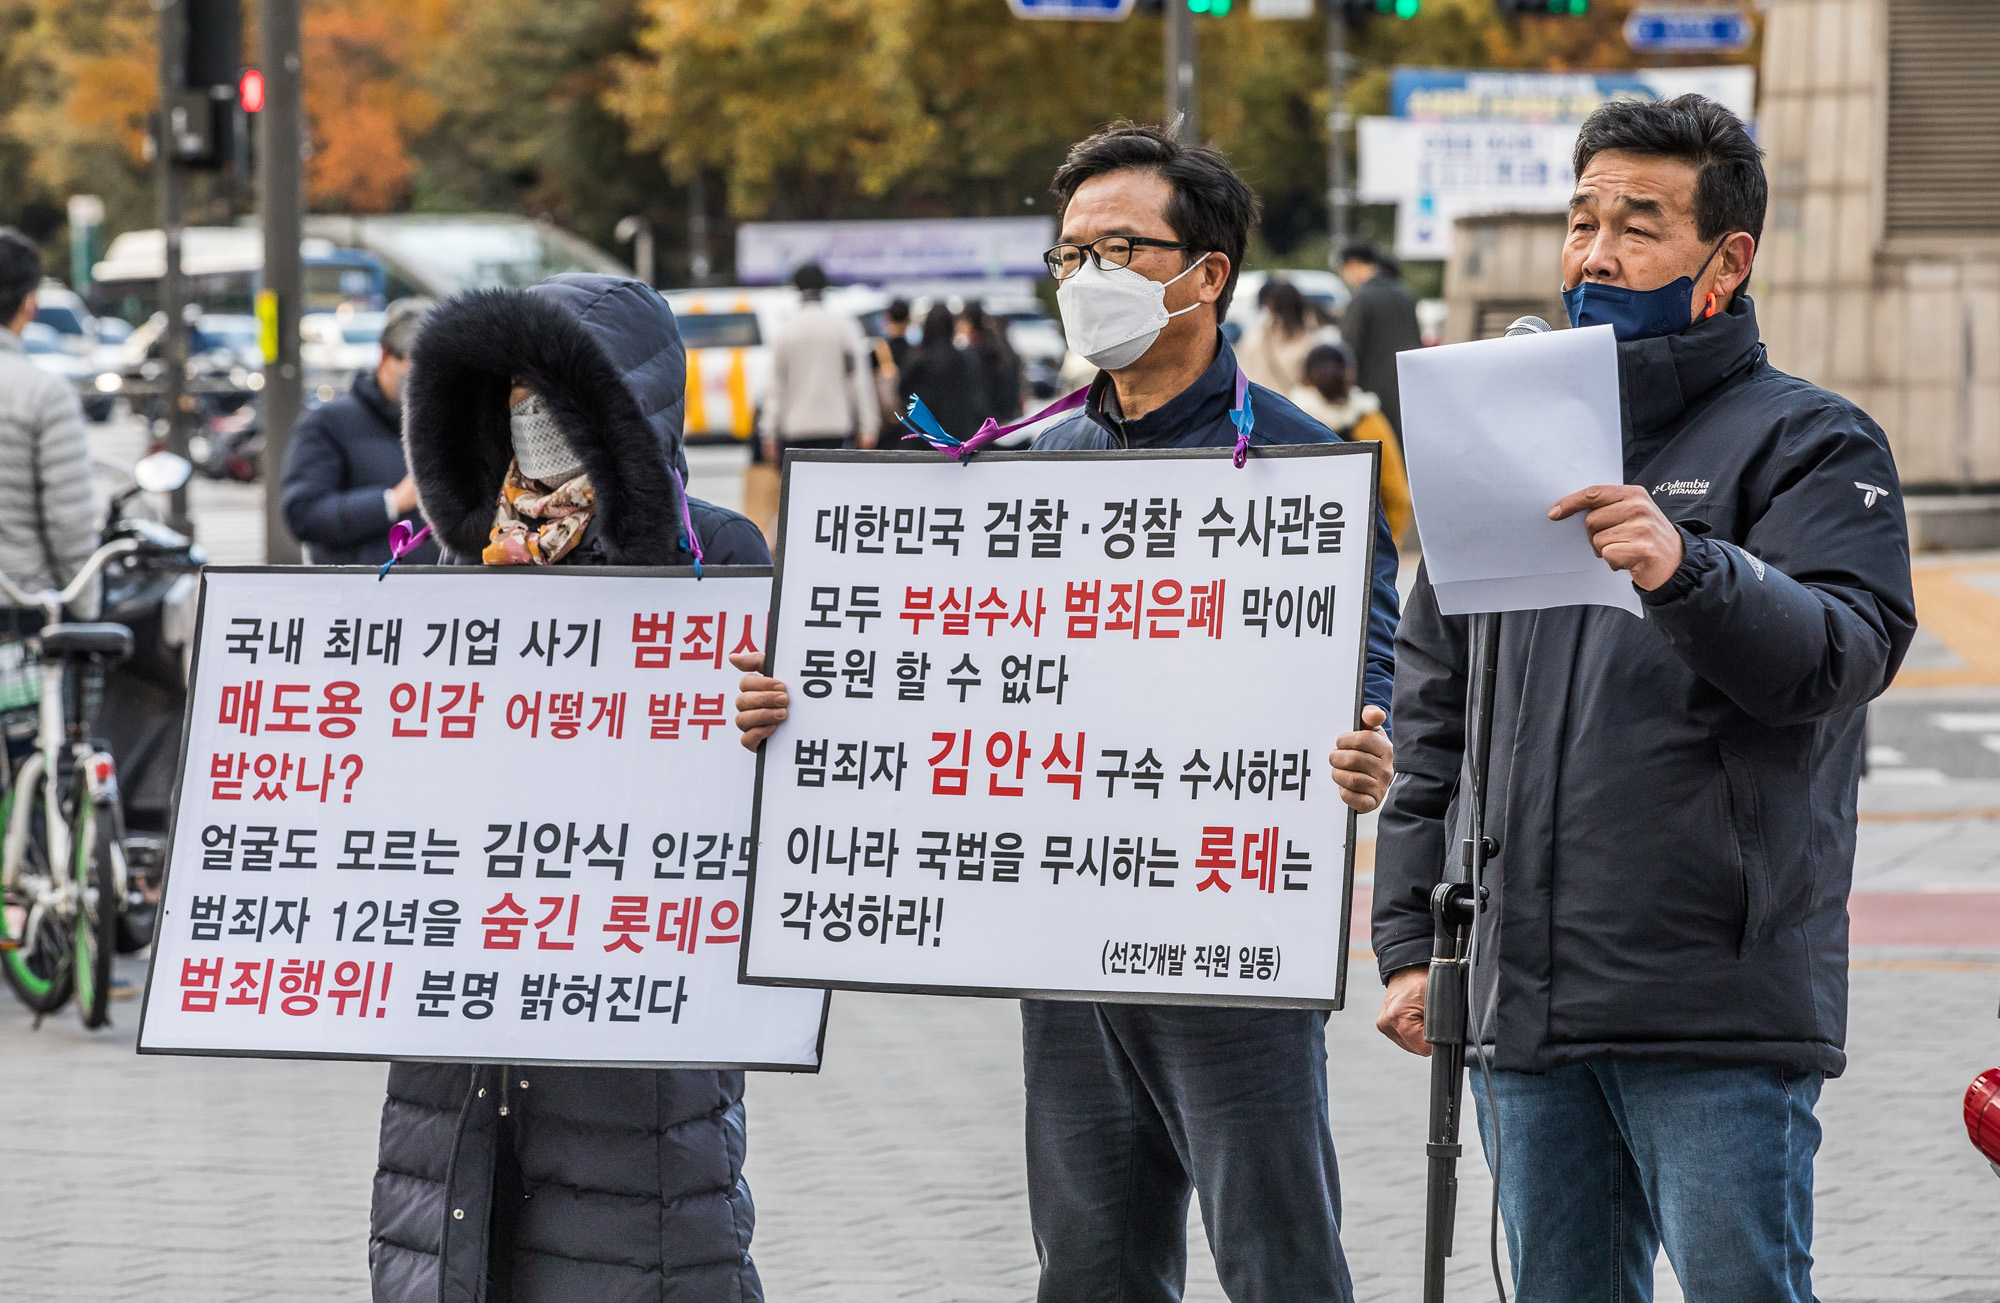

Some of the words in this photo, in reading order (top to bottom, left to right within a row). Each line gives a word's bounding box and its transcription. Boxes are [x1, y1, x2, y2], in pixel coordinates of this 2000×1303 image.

[1660, 479, 1710, 492] Columbia
[1668, 488, 1708, 496] TITANIUM
[815, 505, 964, 556] 대한민국
[1198, 495, 1345, 558] 수사관을
[805, 586, 881, 633] 모두
[900, 586, 1046, 637] 부실수사
[1065, 579, 1225, 639] 범죄은폐
[1243, 585, 1335, 637] 막이에
[226, 618, 304, 664] 국내
[324, 618, 402, 665] 최대
[423, 619, 500, 666] 기업
[519, 619, 601, 667] 사기
[800, 649, 876, 698] 동원
[897, 651, 931, 701] 할
[947, 654, 981, 702] 수
[1001, 655, 1068, 704] 없다
[219, 680, 362, 738] 매도용
[390, 682, 484, 738] 인감
[506, 691, 626, 739] 어떻게
[649, 693, 726, 740] 발부
[210, 752, 363, 803] 받았나?
[795, 739, 907, 791] 범죄자
[928, 729, 1085, 800] 김안식
[1097, 748, 1164, 799] 구속
[1180, 749, 1311, 801] 수사하라
[202, 825, 317, 871] 얼굴도
[337, 829, 460, 875] 모르는
[483, 822, 629, 880] 김안식
[788, 825, 899, 877] 이나라
[917, 831, 1024, 882] 국법을
[1041, 836, 1179, 887] 무시하는
[1195, 827, 1312, 893] 롯데는
[191, 895, 310, 943] 범죄자
[333, 900, 461, 947] 12년을
[481, 893, 580, 950] 숨긴
[780, 891, 943, 947] 각성하라!
[1102, 940, 1186, 976] (선진개발
[1194, 945, 1230, 977] 직원
[1239, 946, 1280, 981] 일동)
[180, 957, 393, 1018] 범죄행위!
[416, 971, 498, 1019] 분명
[521, 973, 688, 1024] 밝혀진다
